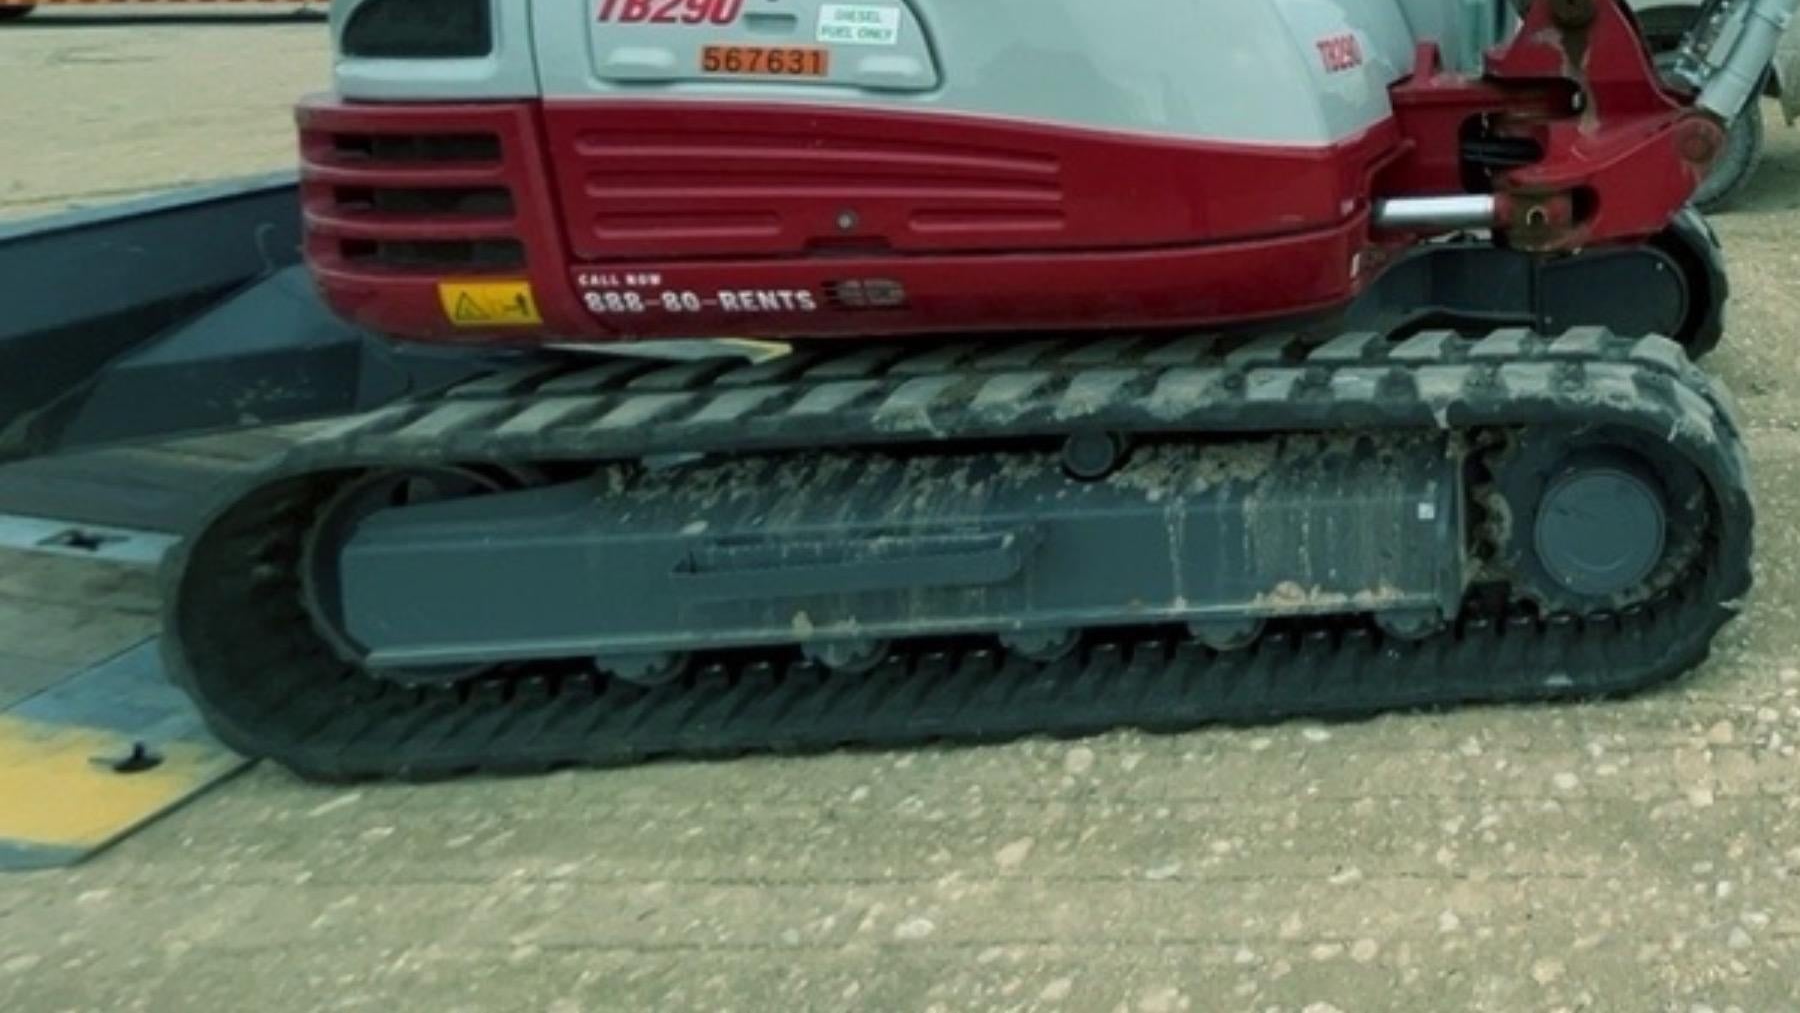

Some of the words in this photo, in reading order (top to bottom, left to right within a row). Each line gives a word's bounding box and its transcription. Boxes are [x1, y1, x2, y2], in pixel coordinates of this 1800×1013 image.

[703, 46, 824, 74] 567631
[578, 274, 619, 285] CALL
[584, 290, 817, 312] 888-80-RENTS
